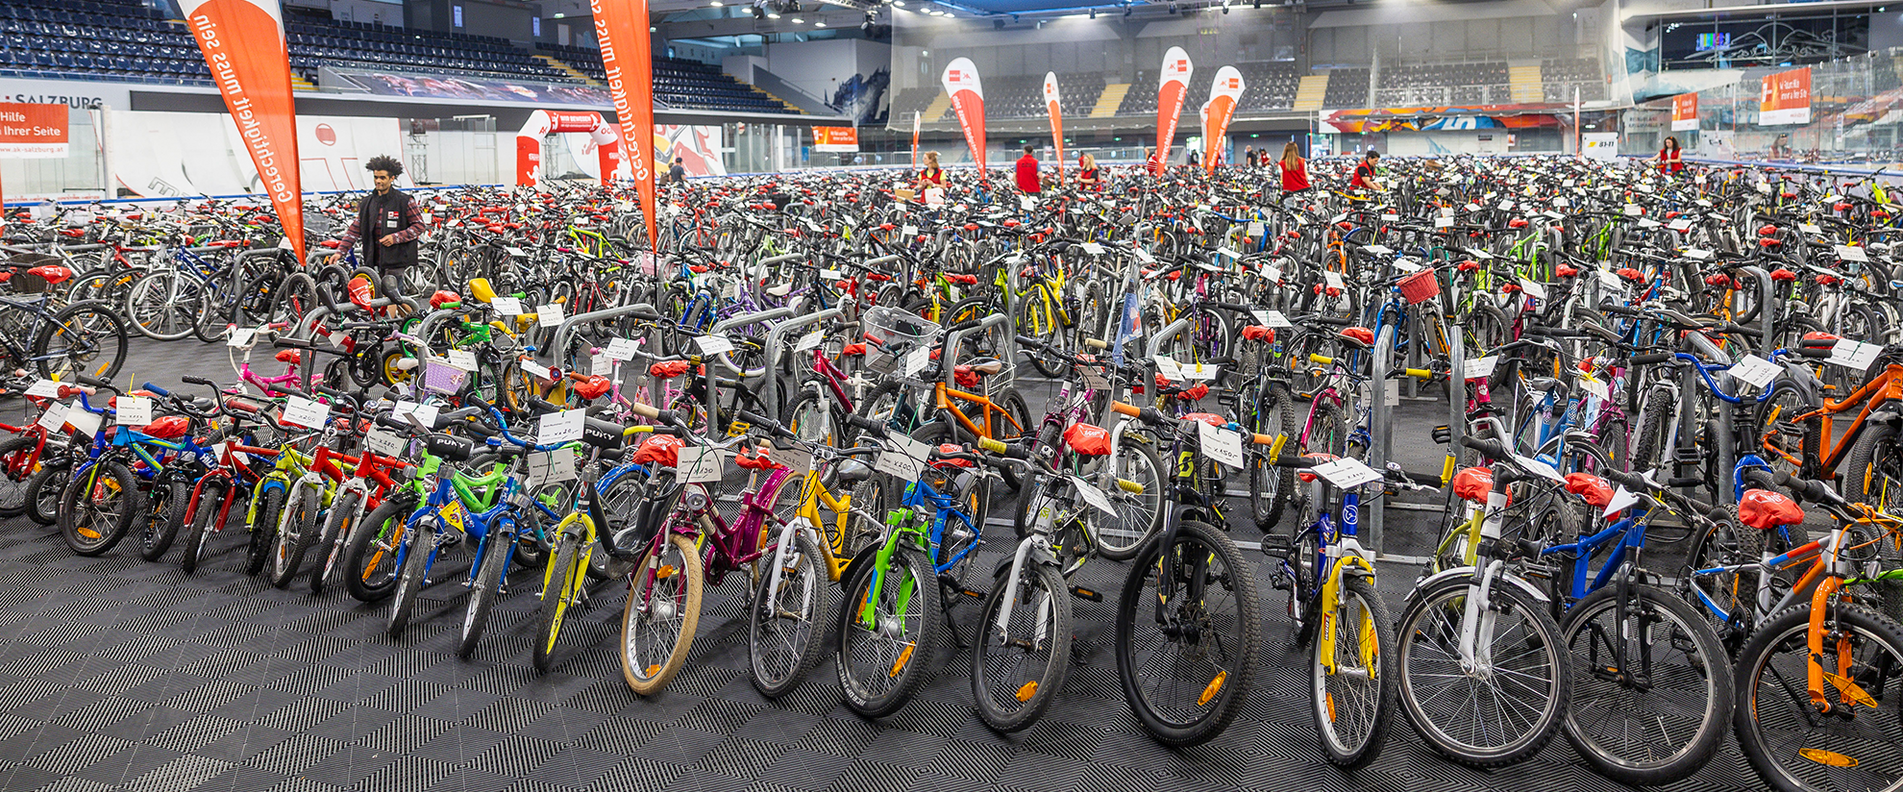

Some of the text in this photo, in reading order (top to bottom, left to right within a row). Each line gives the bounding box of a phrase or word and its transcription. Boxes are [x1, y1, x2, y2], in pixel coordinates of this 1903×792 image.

[0, 111, 26, 122] Hilfe
[3, 125, 61, 136] Ihrer Seite
[1159, 119, 1177, 164] Gerechtigkeit
[1172, 101, 1182, 120] muss
[1177, 86, 1186, 101] sein
[585, 428, 615, 441] PUKY
[436, 438, 466, 449] PUKY
